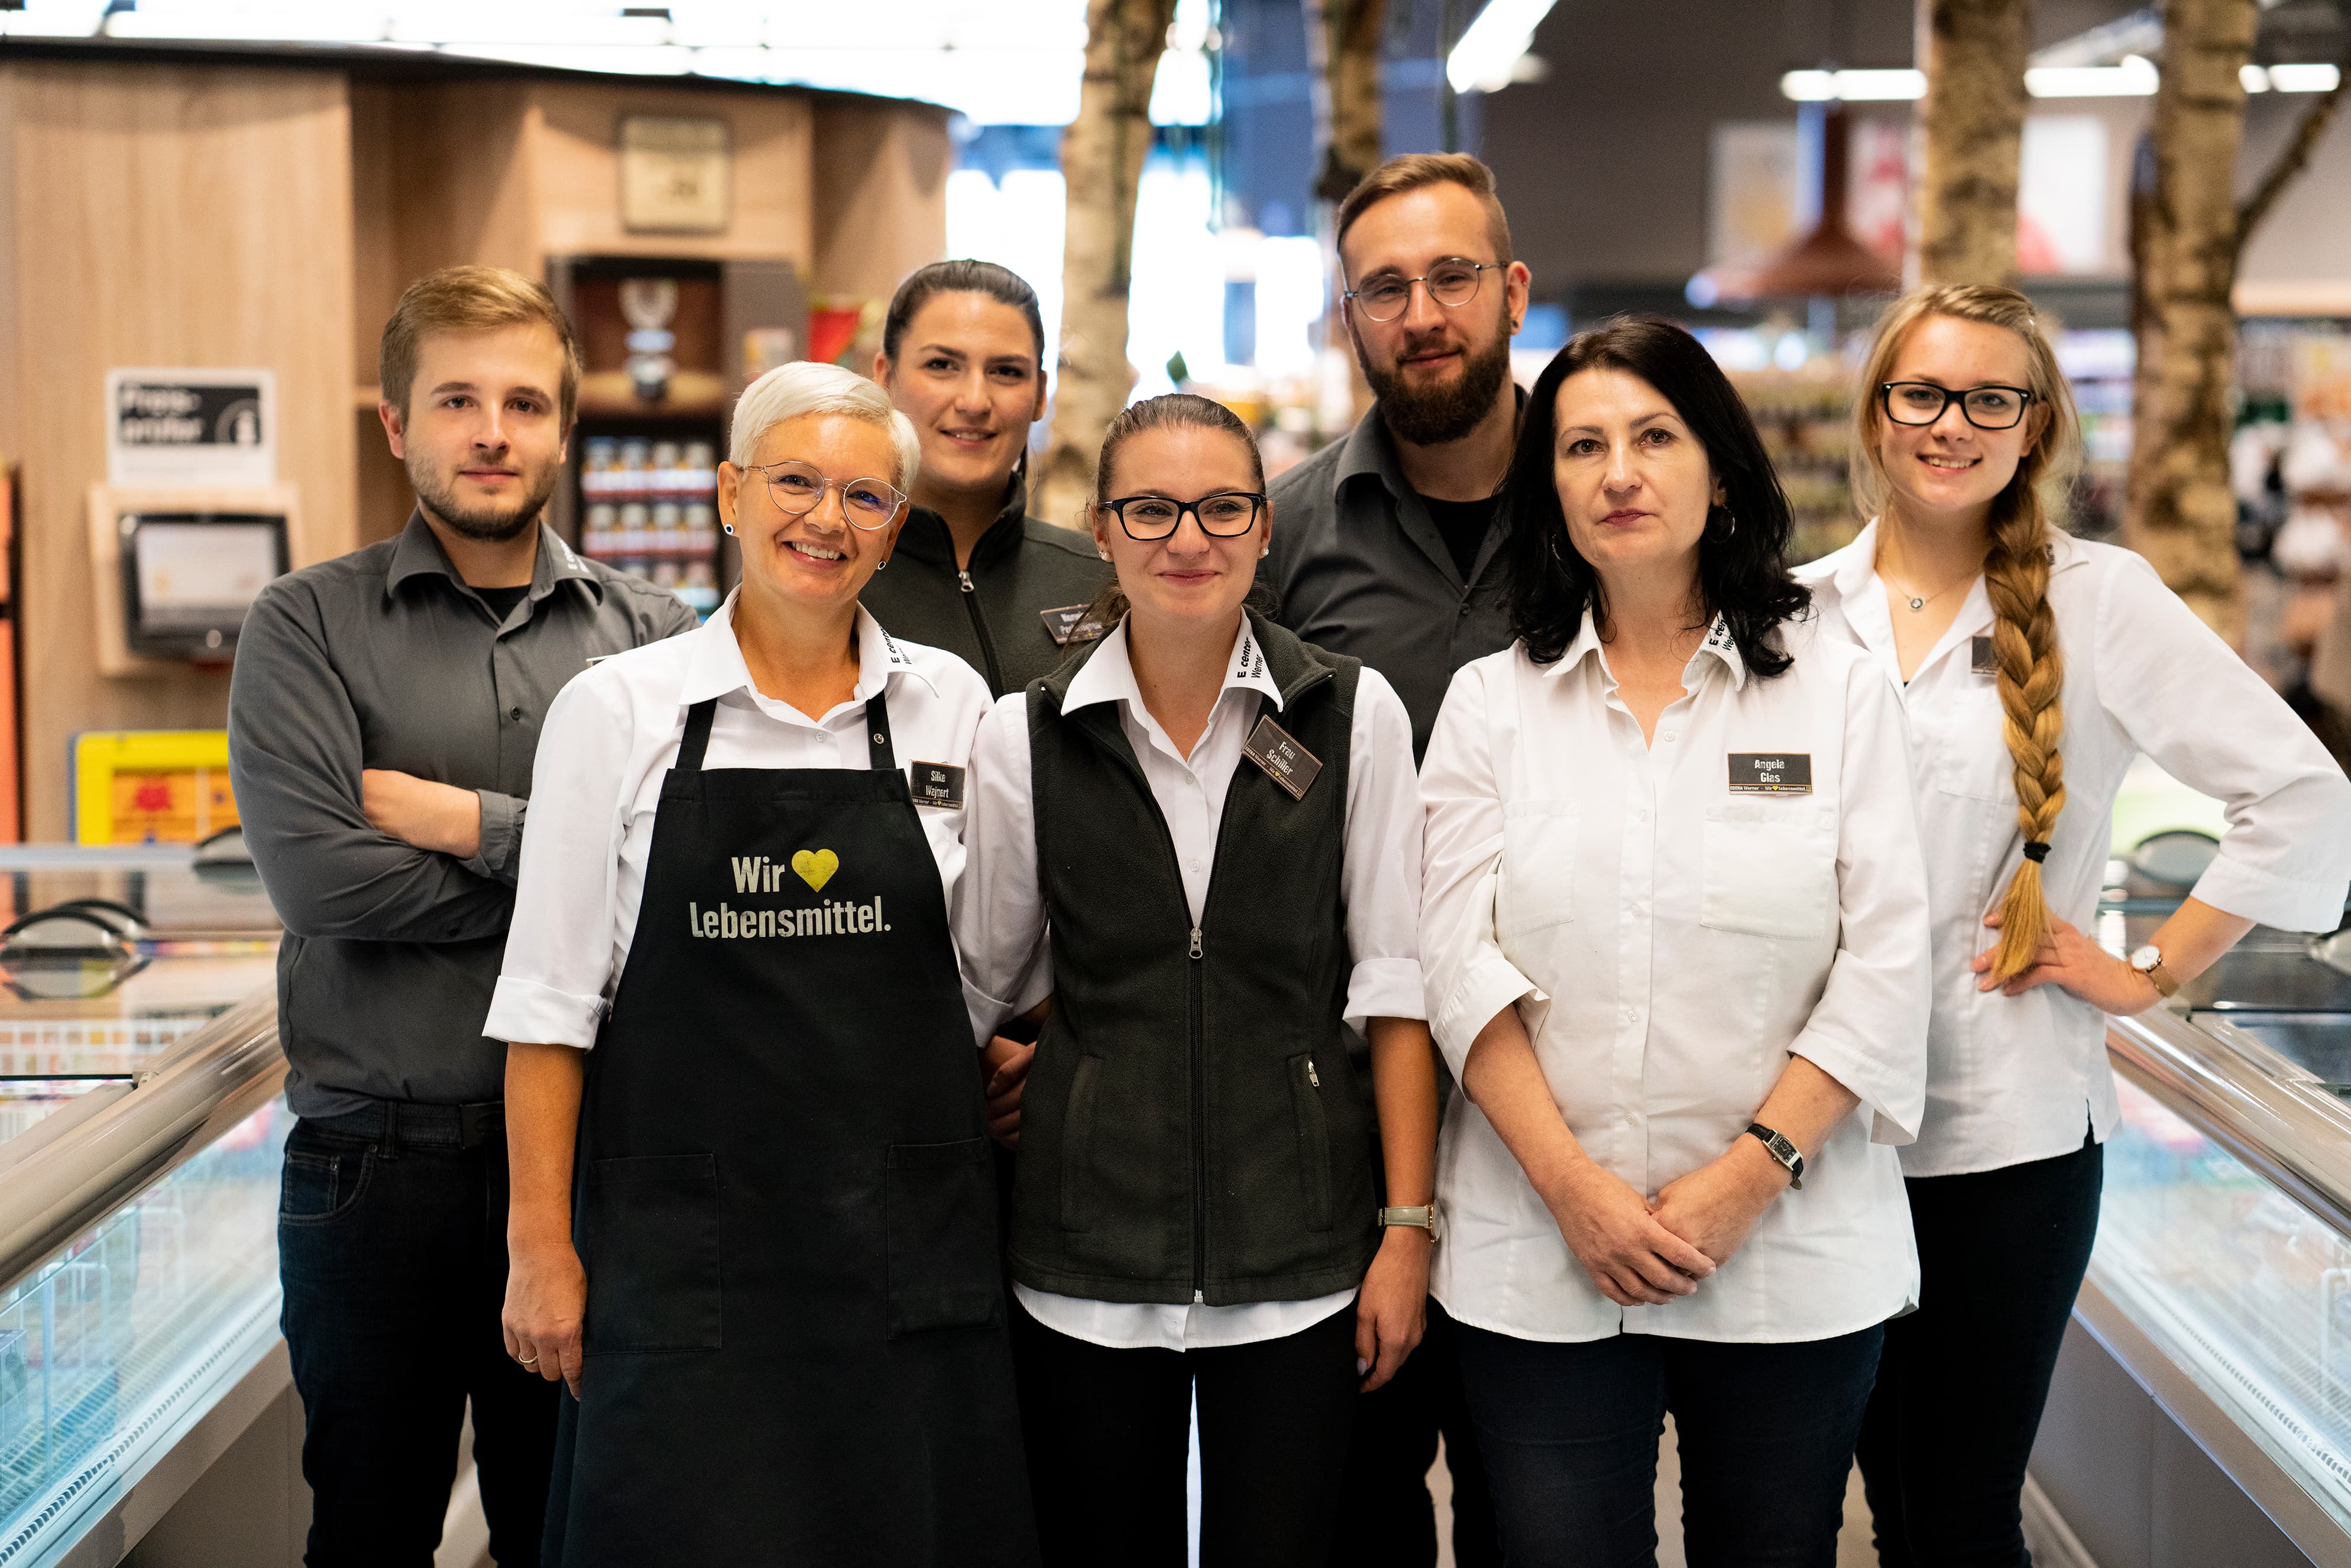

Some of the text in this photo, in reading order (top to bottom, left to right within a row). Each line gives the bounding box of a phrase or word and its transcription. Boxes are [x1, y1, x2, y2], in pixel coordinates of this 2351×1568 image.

[1715, 619, 1726, 637] cen
[1241, 636, 1251, 667] center
[1251, 654, 1263, 678] Werner
[1278, 741, 1296, 760] Frau
[1266, 749, 1294, 776] Schiller
[1754, 759, 1785, 771] Angela
[931, 770, 946, 783] Silke
[1760, 772, 1781, 783] Glas
[925, 785, 950, 799] Wajnert
[731, 856, 785, 893] Wir
[689, 896, 891, 939] Lebensmittel.
